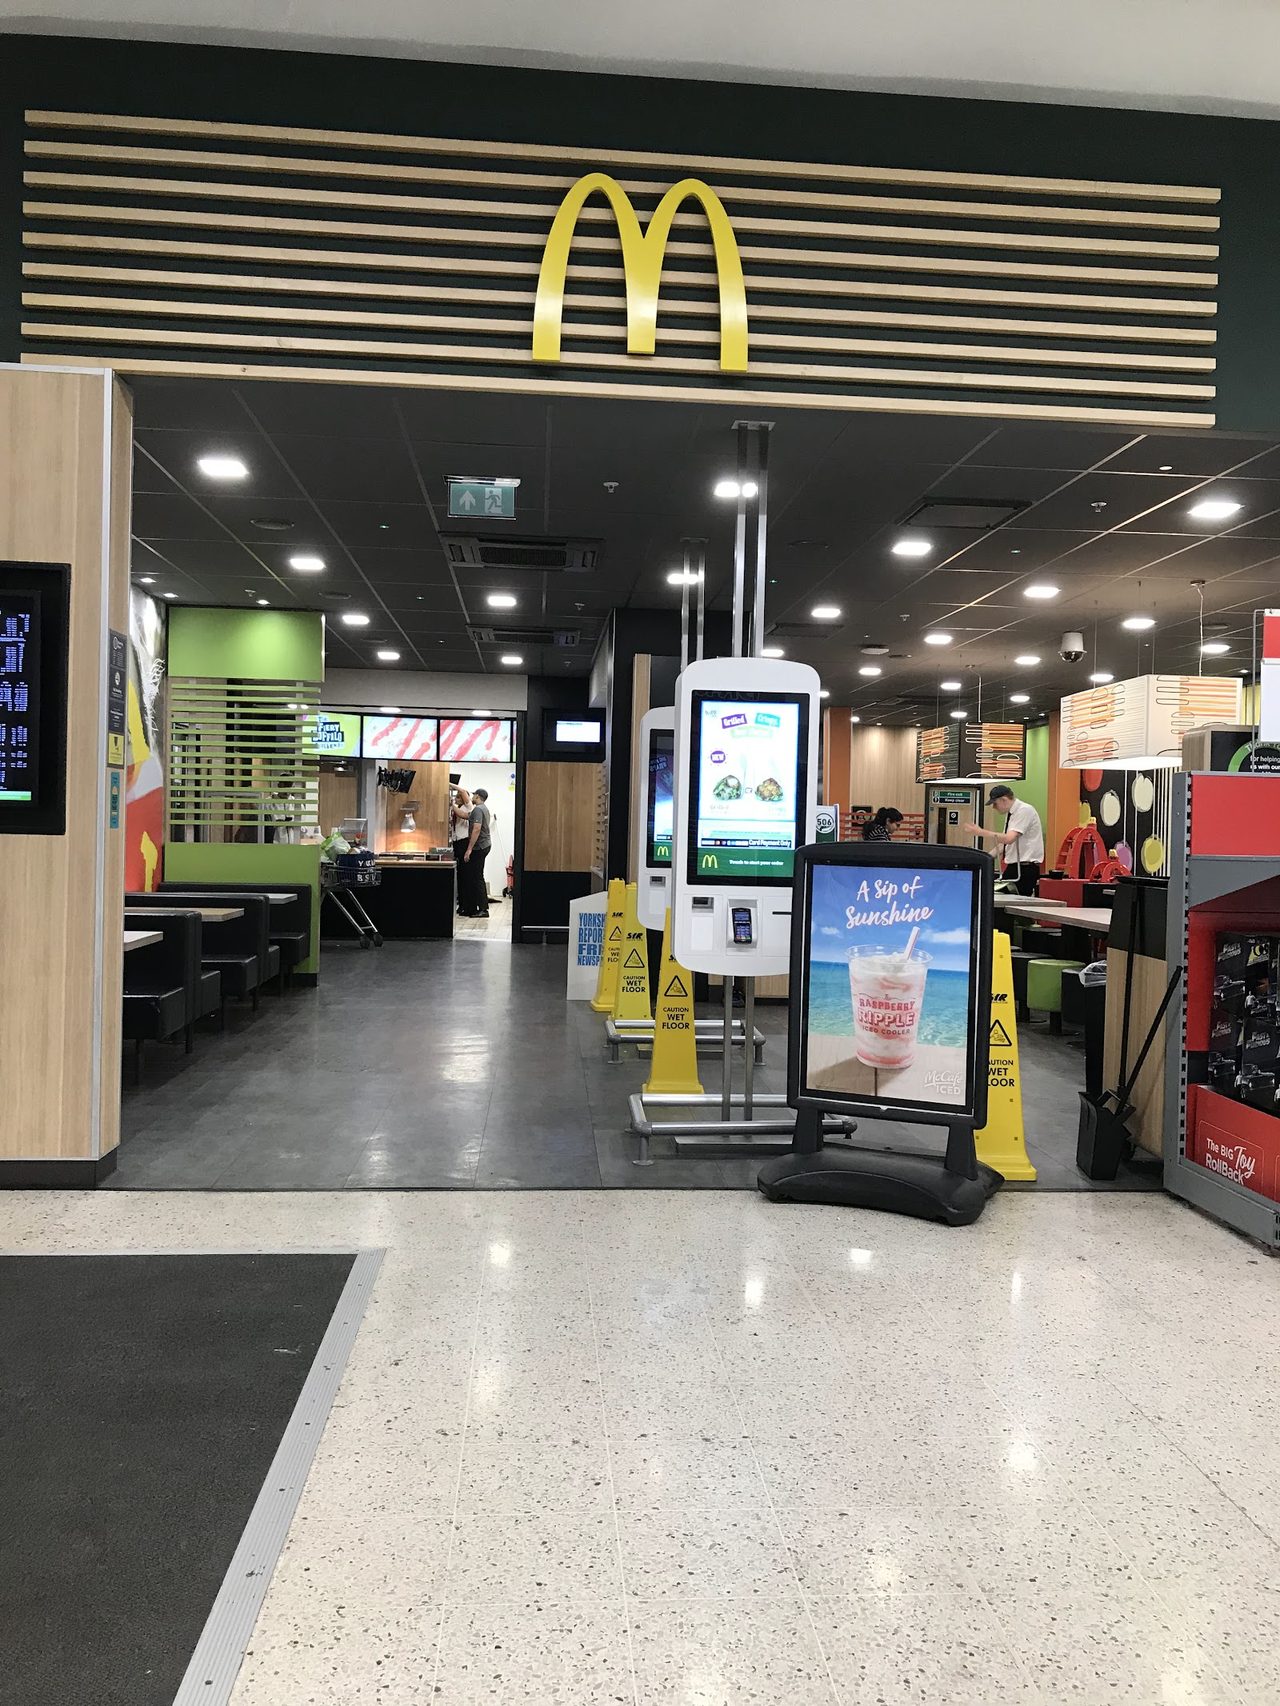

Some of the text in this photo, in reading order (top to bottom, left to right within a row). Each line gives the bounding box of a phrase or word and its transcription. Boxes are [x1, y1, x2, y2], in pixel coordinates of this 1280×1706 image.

[816, 818, 832, 826] 506
[761, 839, 780, 848] Payment
[856, 876, 924, 904] A Sip of
[846, 900, 934, 929] Sunshine
[577, 956, 603, 966] NEWSP
[859, 998, 915, 1012] RASPBERRY
[858, 1008, 914, 1028] RIPPLE
[988, 1068, 1008, 1076] WET
[936, 1086, 961, 1095] ICED
[1206, 1138, 1256, 1178] The BIG Toy
[1206, 1152, 1244, 1186] RollBack
